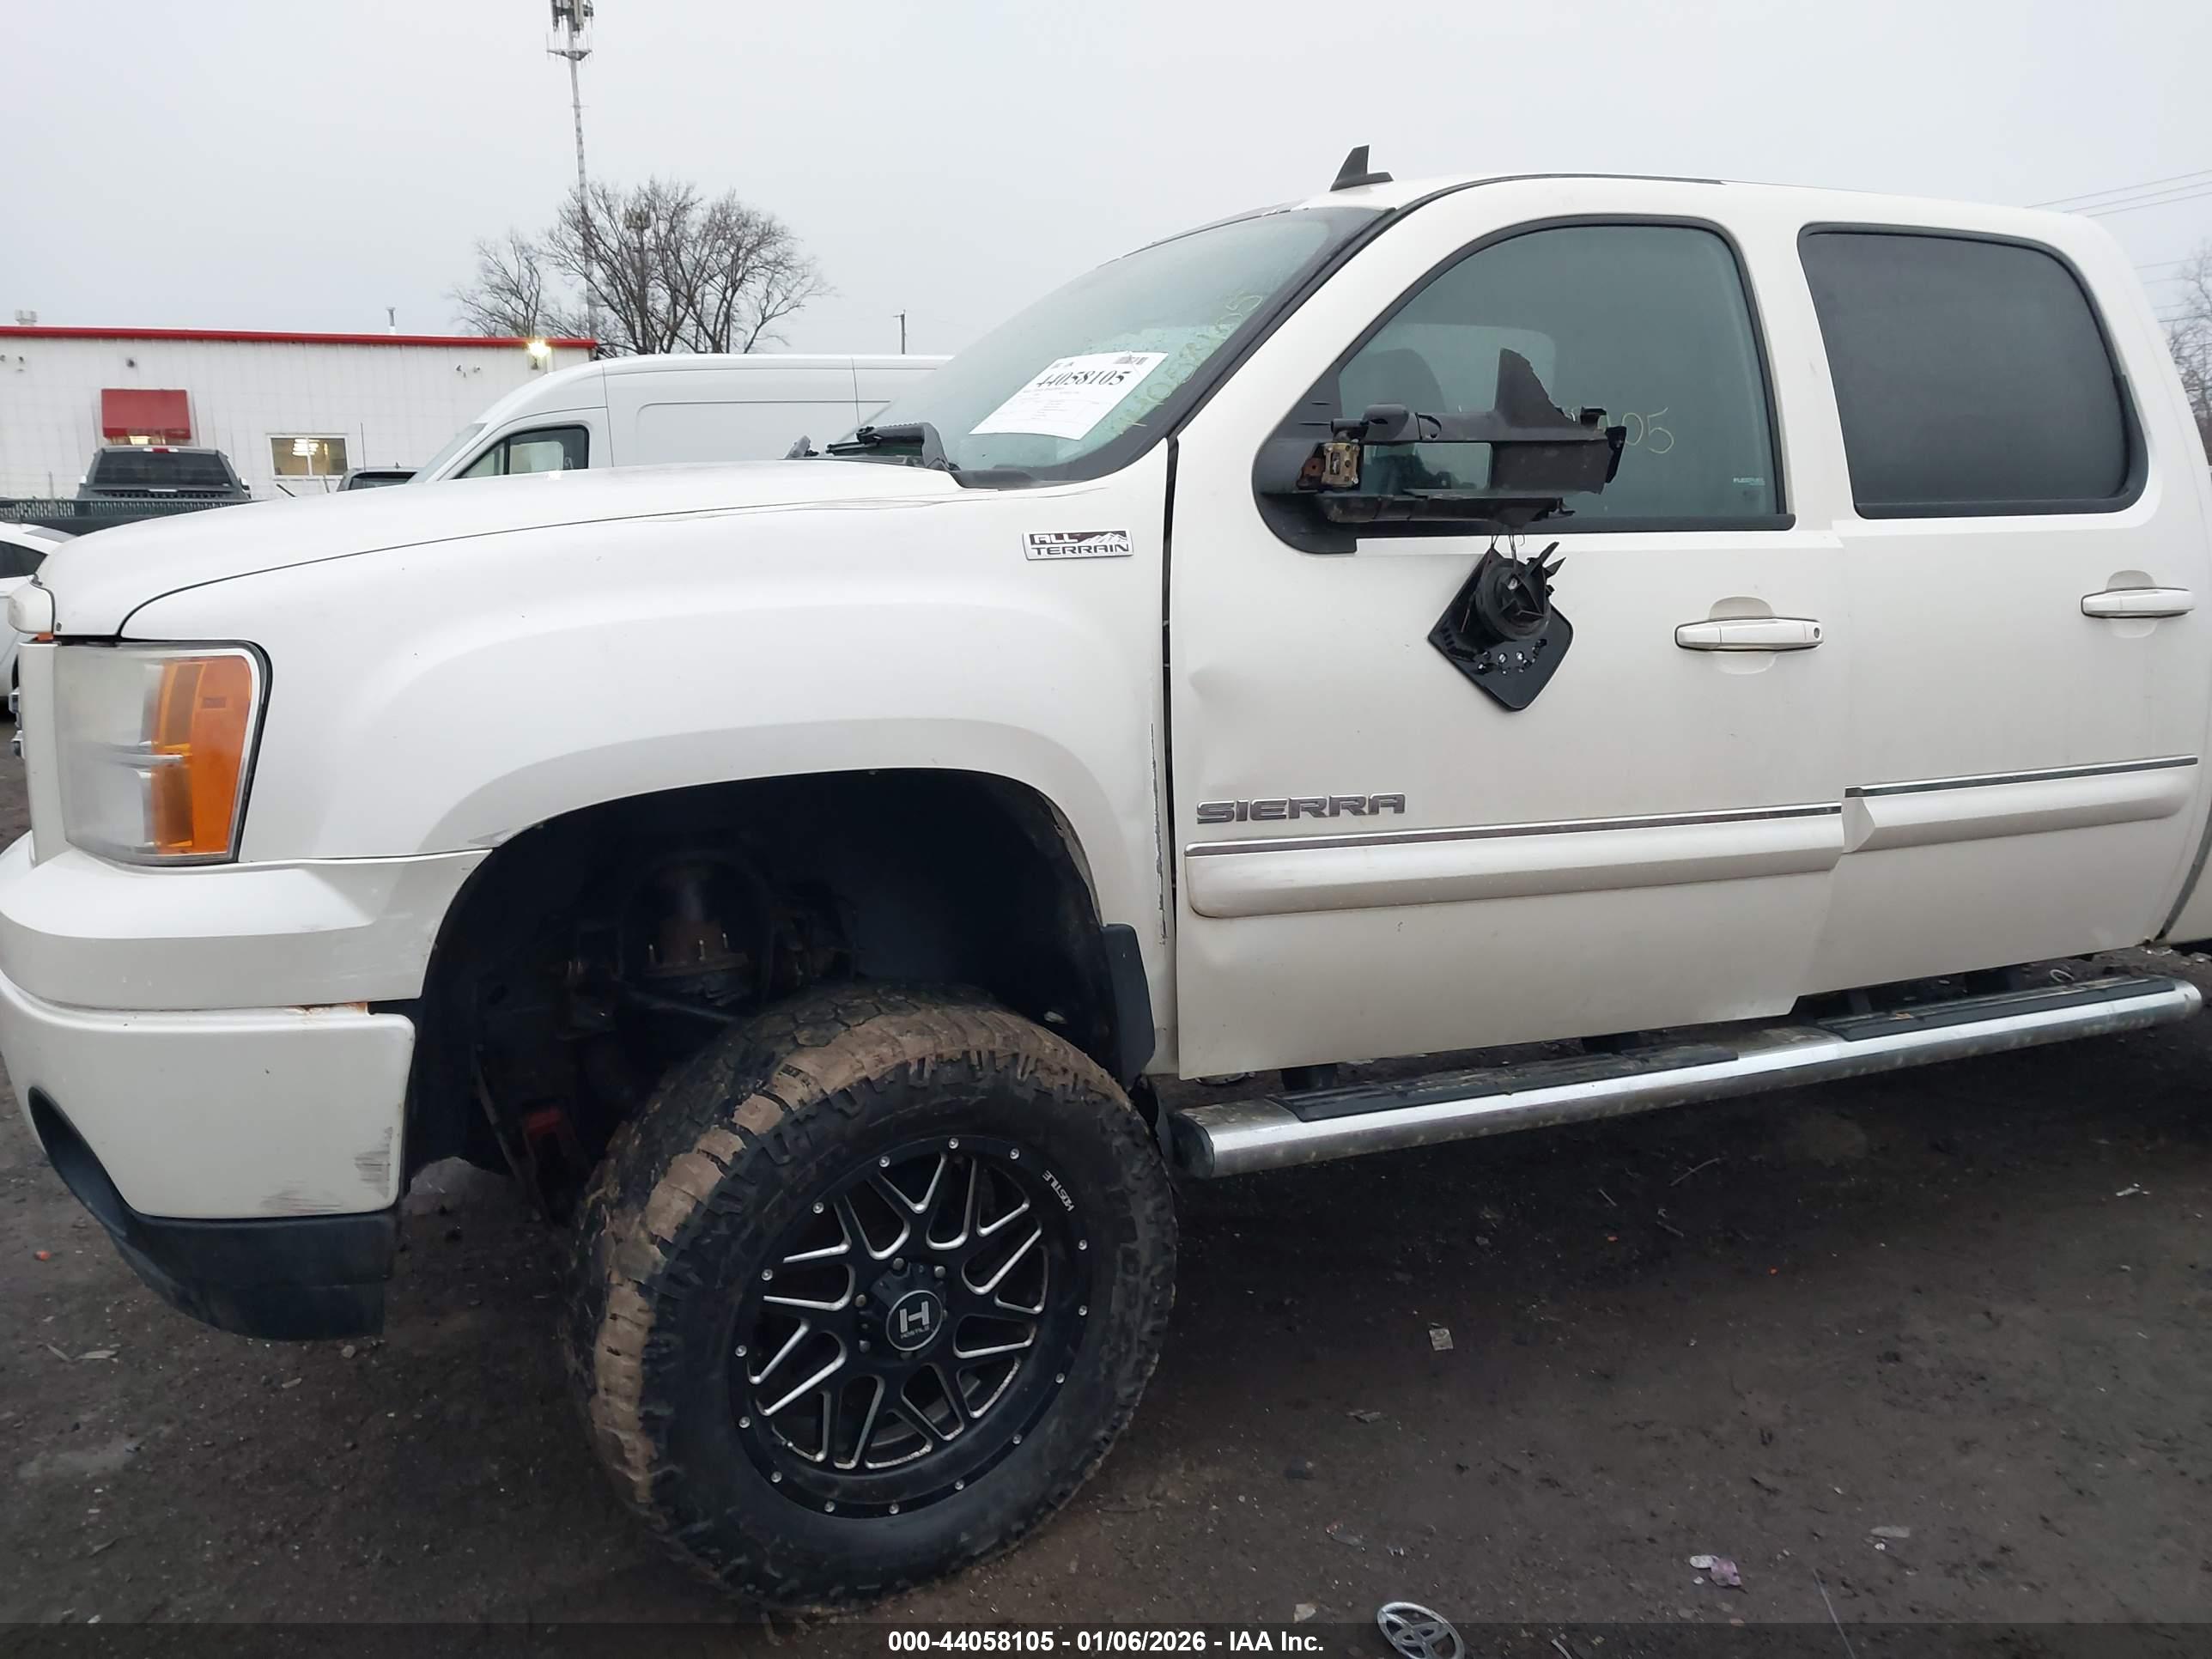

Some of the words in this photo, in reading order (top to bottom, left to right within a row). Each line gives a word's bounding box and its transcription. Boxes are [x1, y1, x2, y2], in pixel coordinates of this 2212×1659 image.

[1036, 370, 1131, 388] 44058105
[1030, 544, 1129, 556] TERRAIN
[1033, 533, 1079, 544] ALL
[1196, 792, 1407, 824] SIERRA
[1042, 1170, 1075, 1212] HOSTILE
[899, 1300, 930, 1334] H
